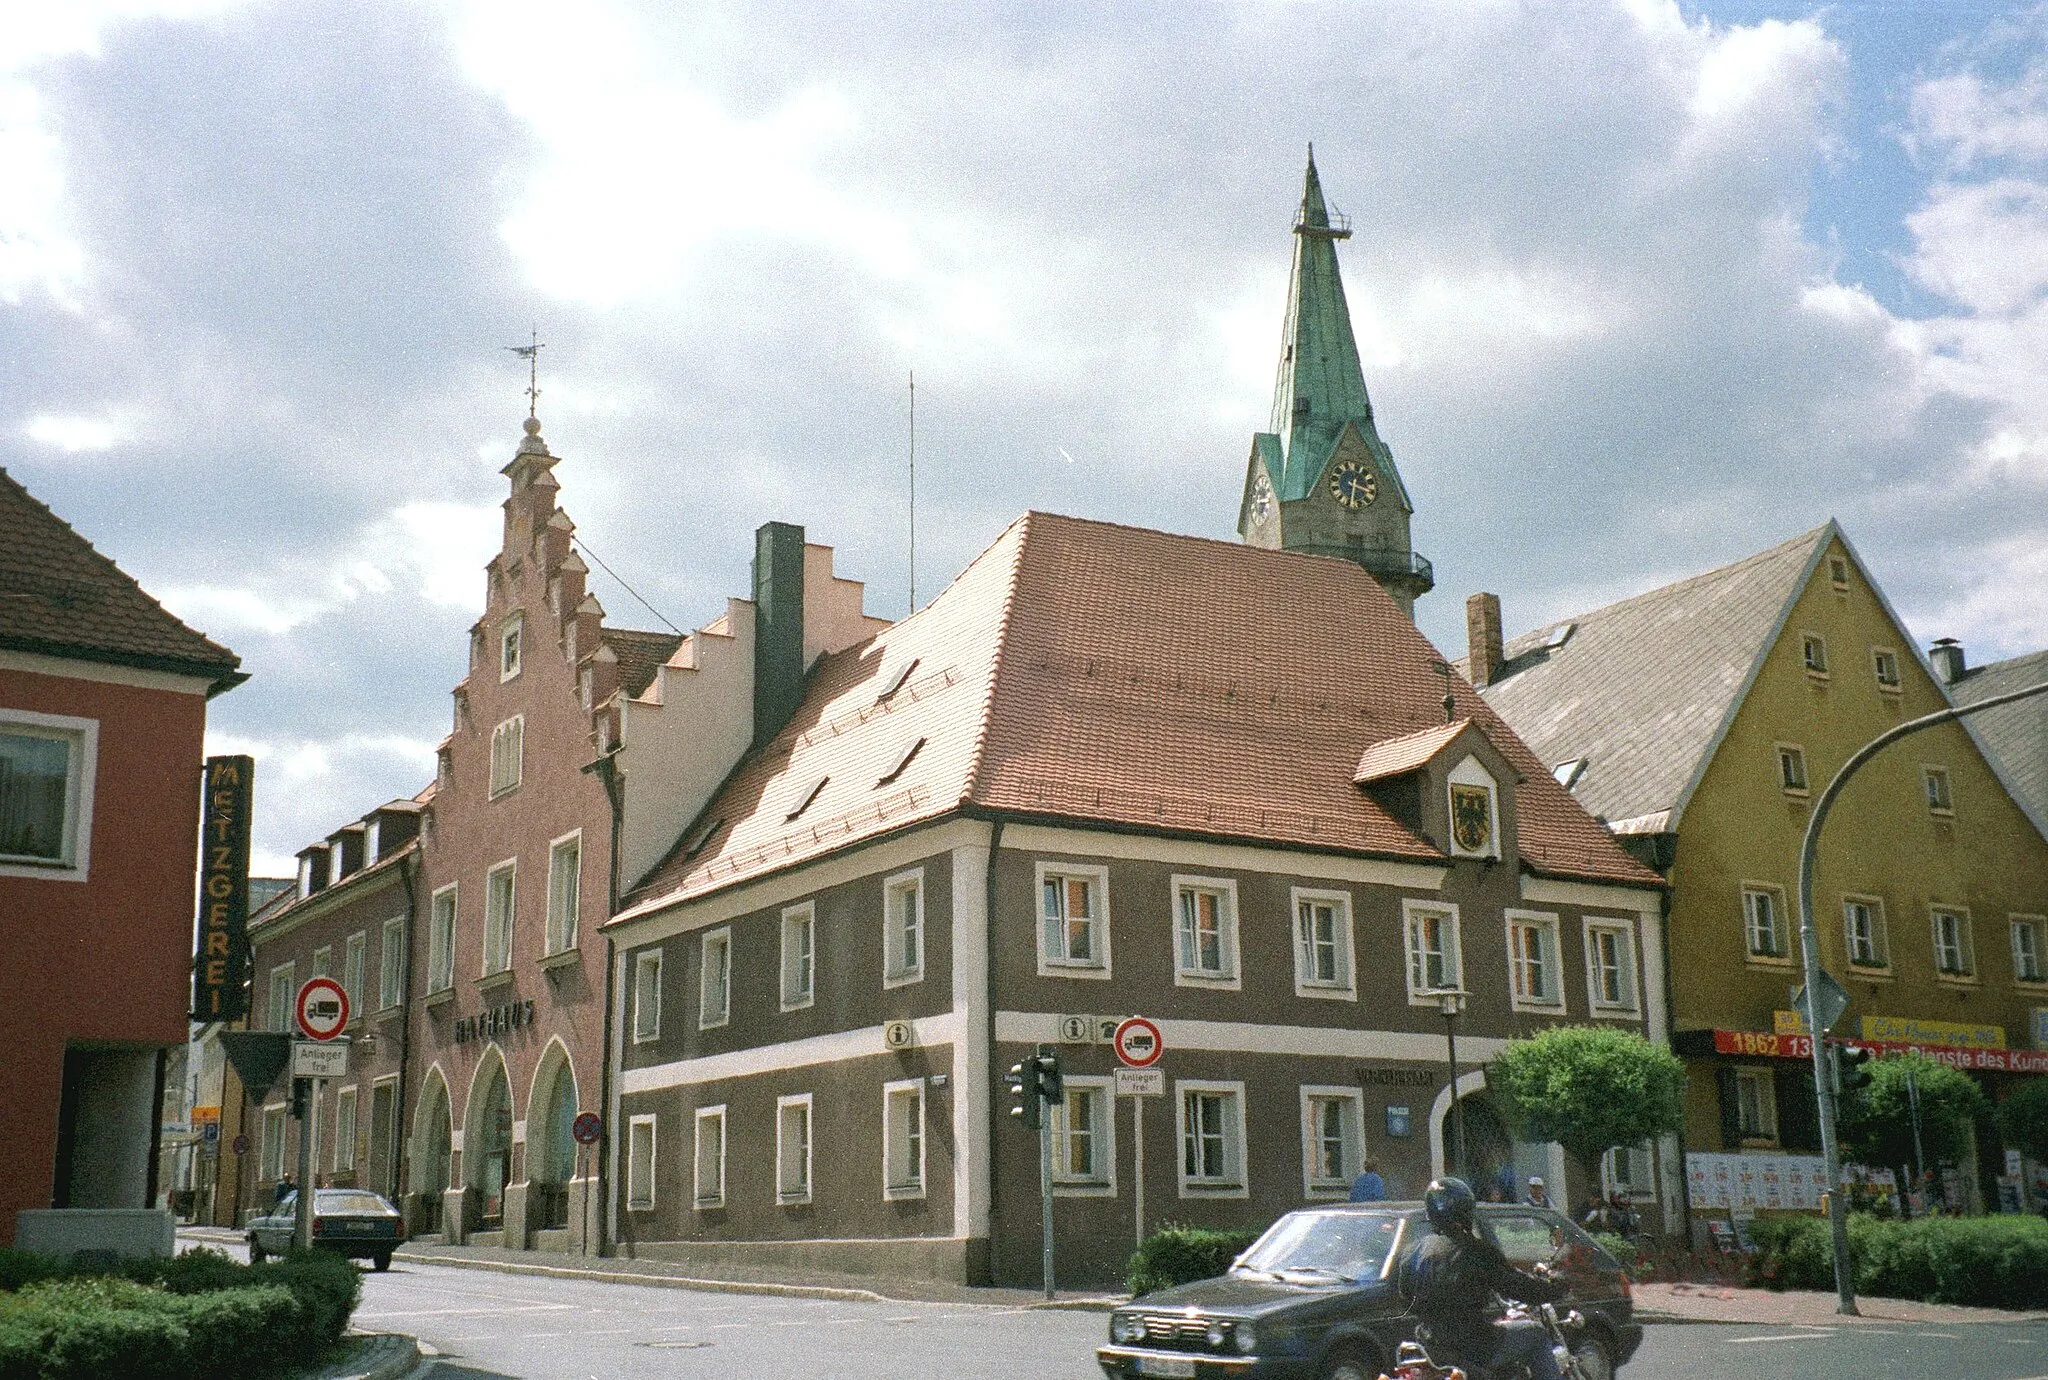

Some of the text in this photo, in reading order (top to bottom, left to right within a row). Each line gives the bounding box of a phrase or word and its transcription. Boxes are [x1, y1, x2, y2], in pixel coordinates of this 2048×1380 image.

[206, 763, 239, 1013] METZGEREI
[456, 1000, 534, 1043] RATHAUS
[301, 1048, 342, 1062] Anlieger
[1733, 1032, 1781, 1057] 1862
[1976, 1050, 2005, 1068] des
[1121, 1074, 1159, 1084] Anlieger
[1132, 1083, 1148, 1092] frei
